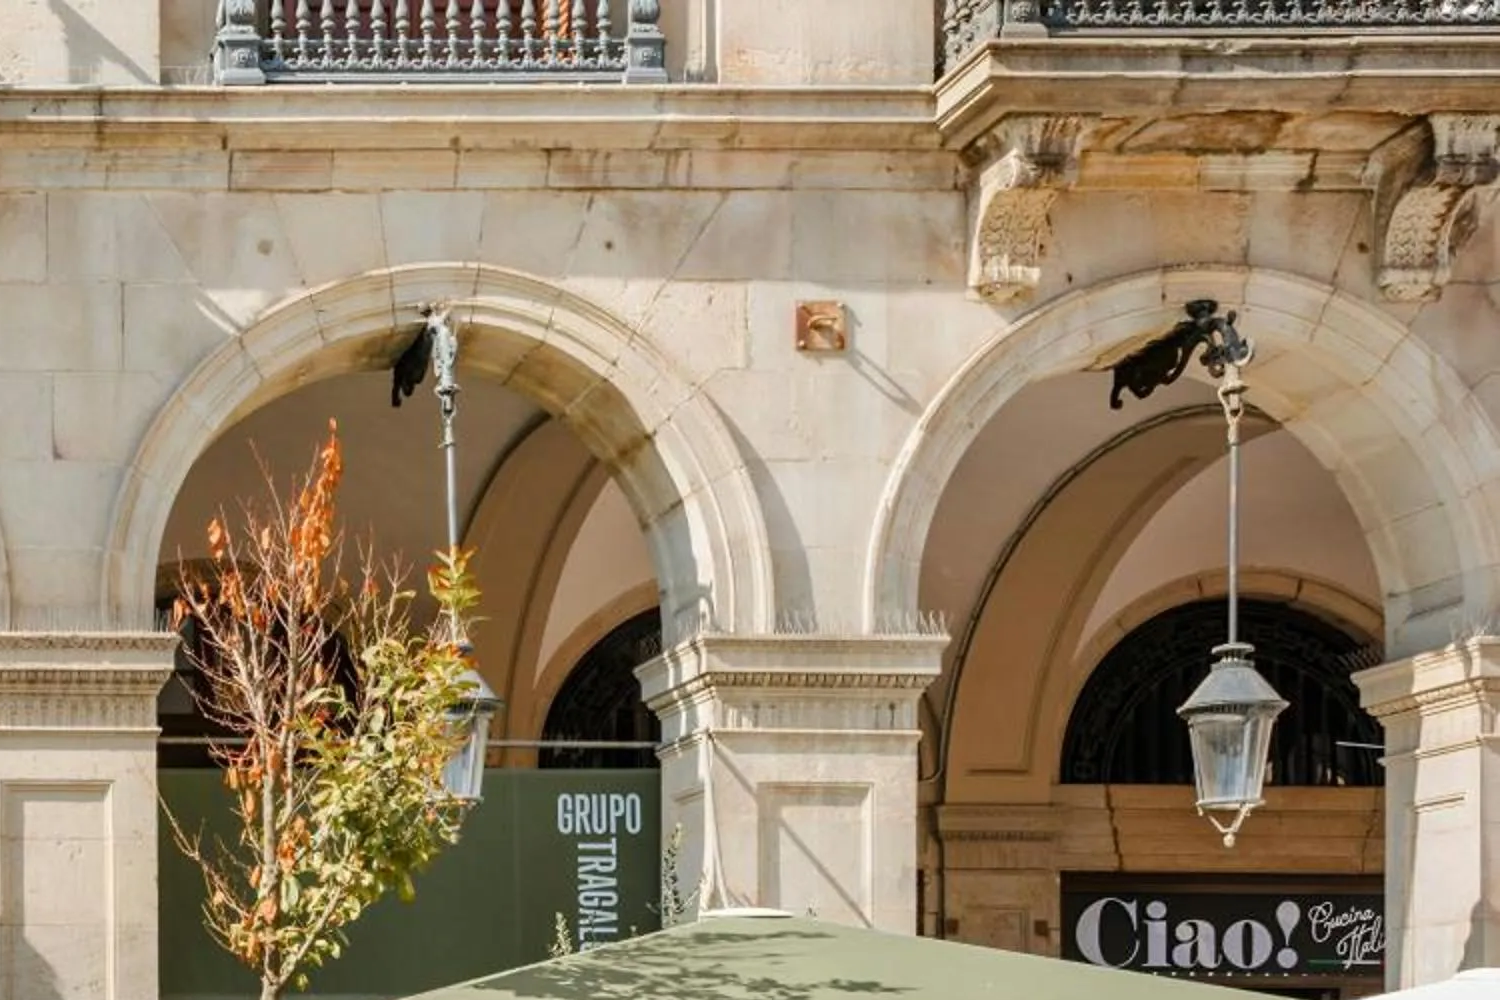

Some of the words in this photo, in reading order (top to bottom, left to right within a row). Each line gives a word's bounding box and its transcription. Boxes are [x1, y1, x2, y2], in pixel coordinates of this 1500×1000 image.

[557, 793, 642, 835] GRUPO
[1075, 897, 1301, 969] Ciao!
[1308, 901, 1374, 943] Cucina
[1336, 915, 1388, 970] Itali
